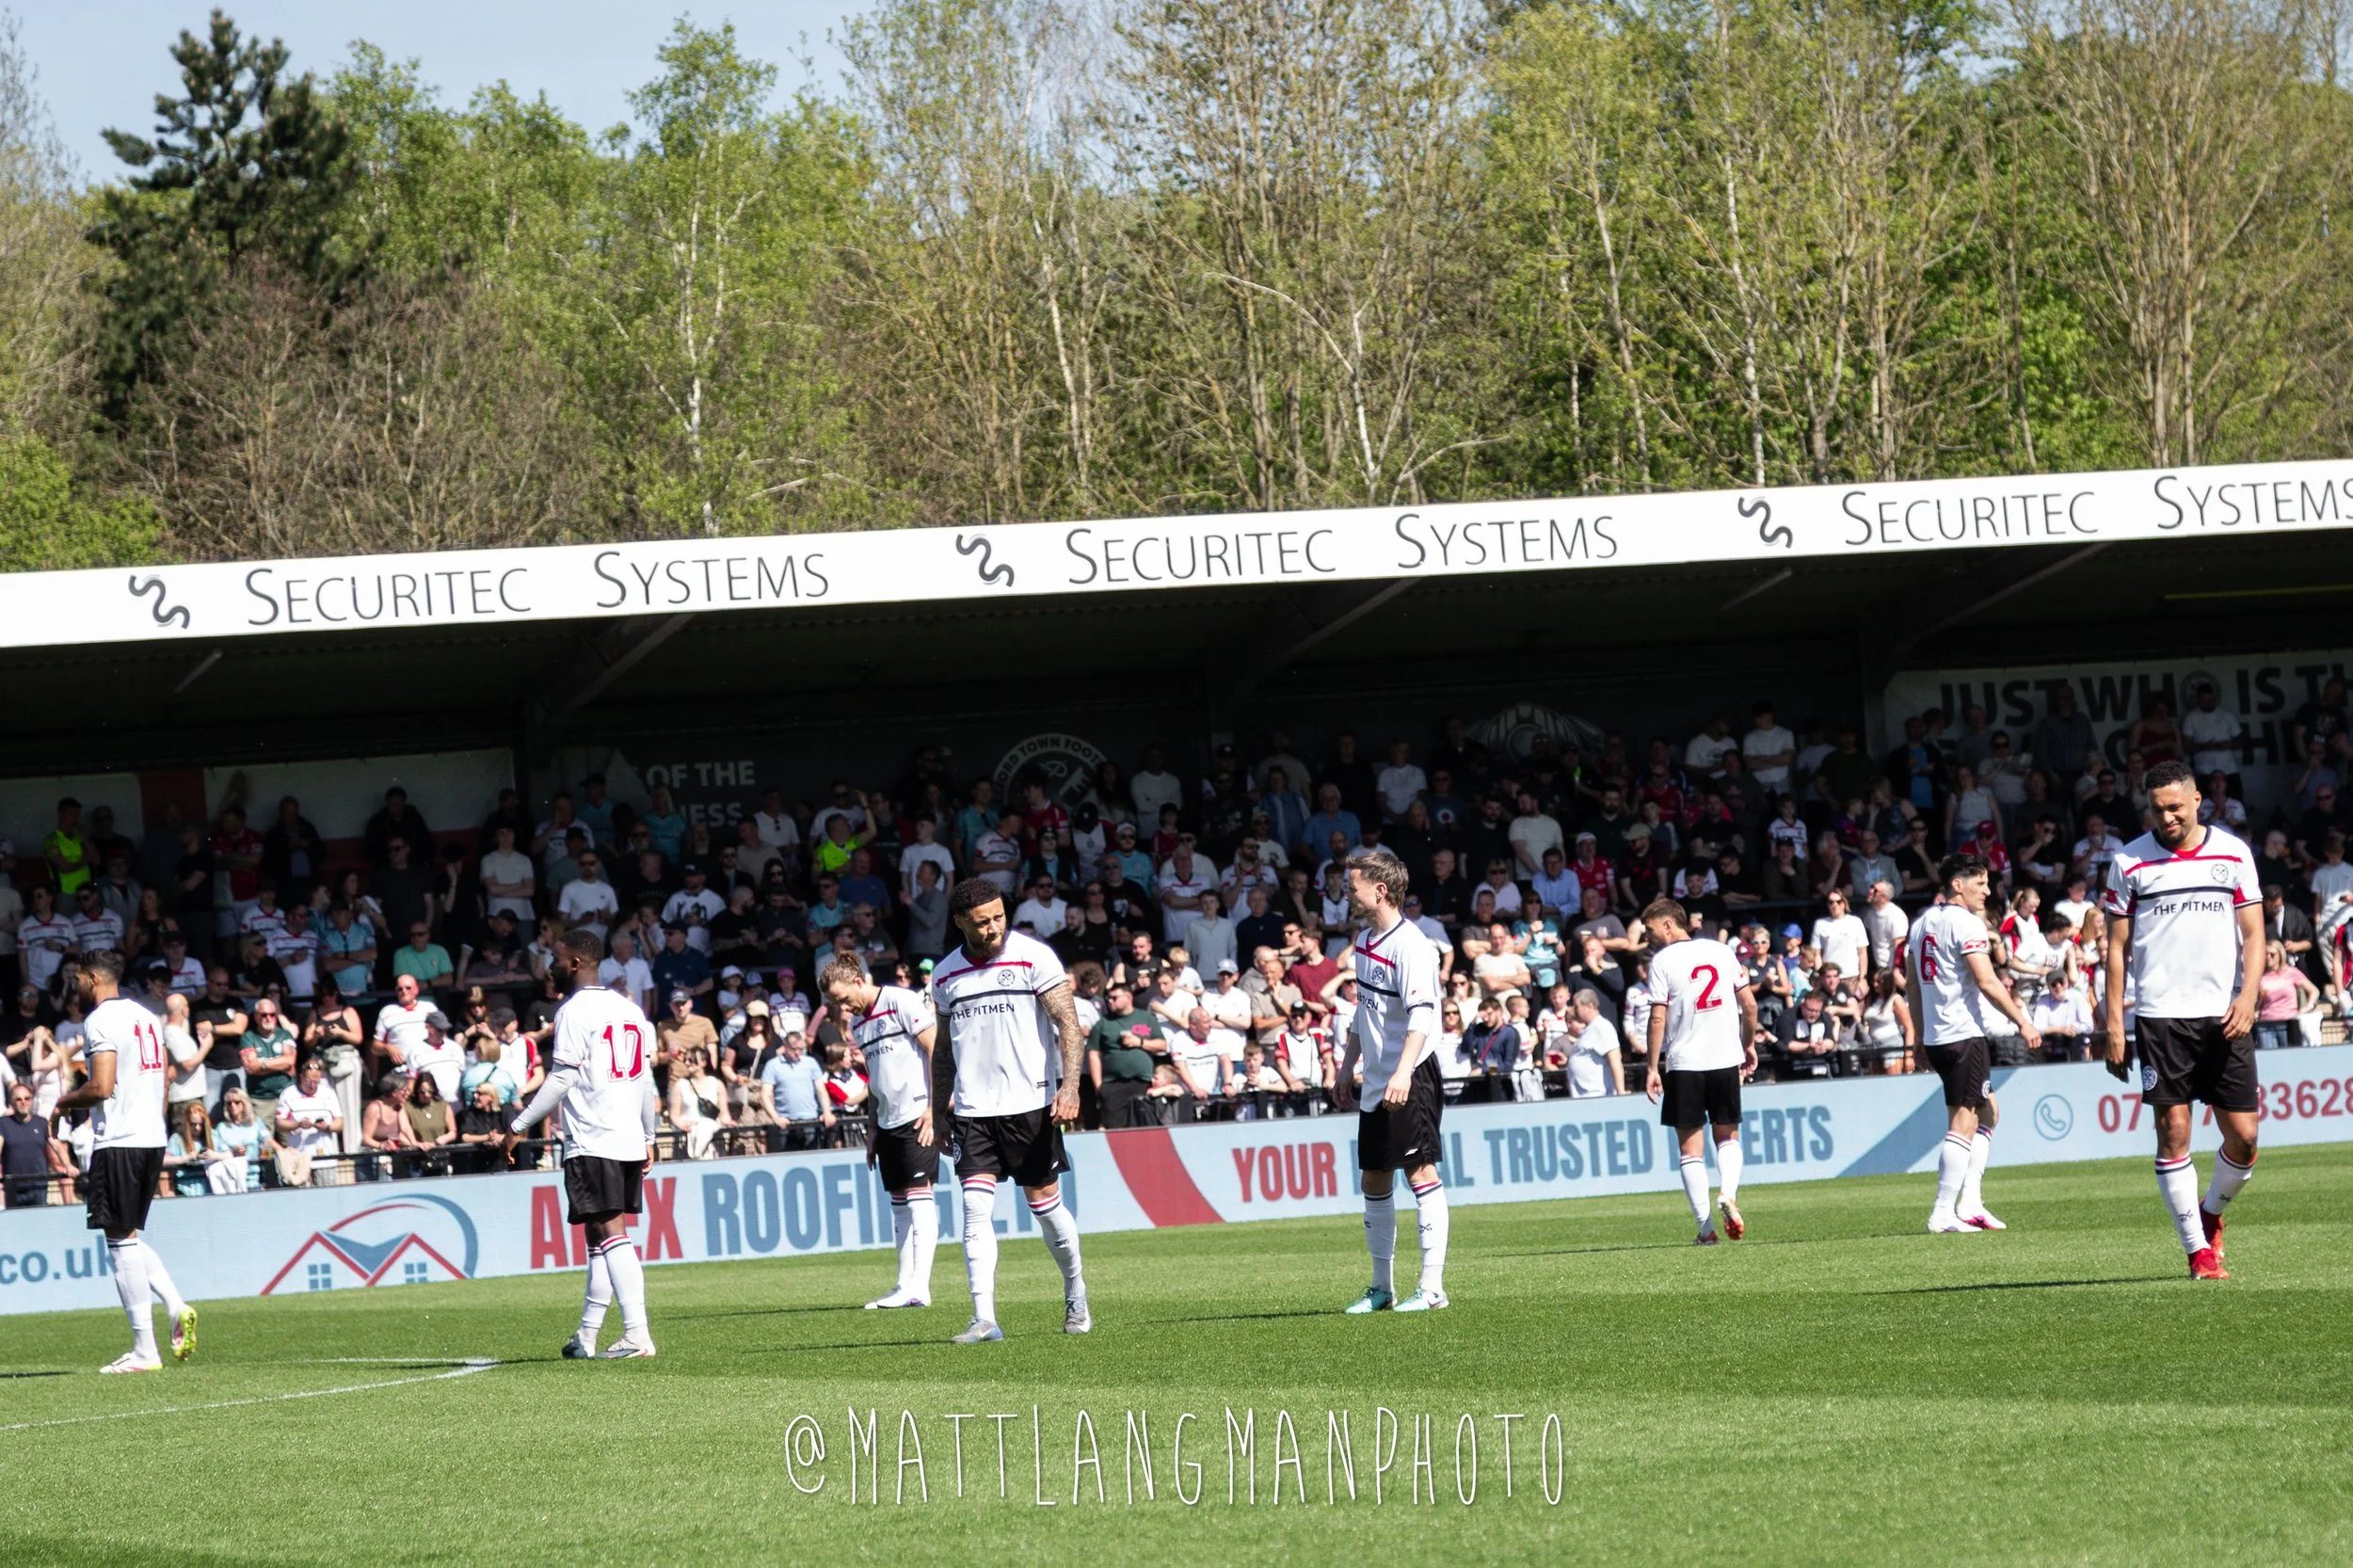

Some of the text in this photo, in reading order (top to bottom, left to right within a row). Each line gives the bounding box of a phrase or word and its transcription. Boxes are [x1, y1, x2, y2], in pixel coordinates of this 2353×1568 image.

[1842, 490, 2098, 546] SECURITEC
[1064, 513, 1618, 584] SECURITEC SYSTEMS
[245, 551, 830, 626] SECURITEC SYSTEMS
[1939, 677, 2069, 728] JUST
[2236, 667, 2285, 714] IS
[646, 760, 756, 789] OF THE
[2153, 903, 2177, 917] THE
[1920, 934, 1939, 984] 6
[973, 1002, 1015, 1016] PITMEN
[1689, 964, 1723, 1013] 2
[133, 1022, 163, 1072] 11
[600, 1021, 645, 1081] 10
[1232, 1141, 1337, 1203] YOUR
[1483, 1118, 1654, 1186] TRUSTED
[531, 1176, 684, 1269] AX
[702, 1158, 955, 1256] ROOFI
